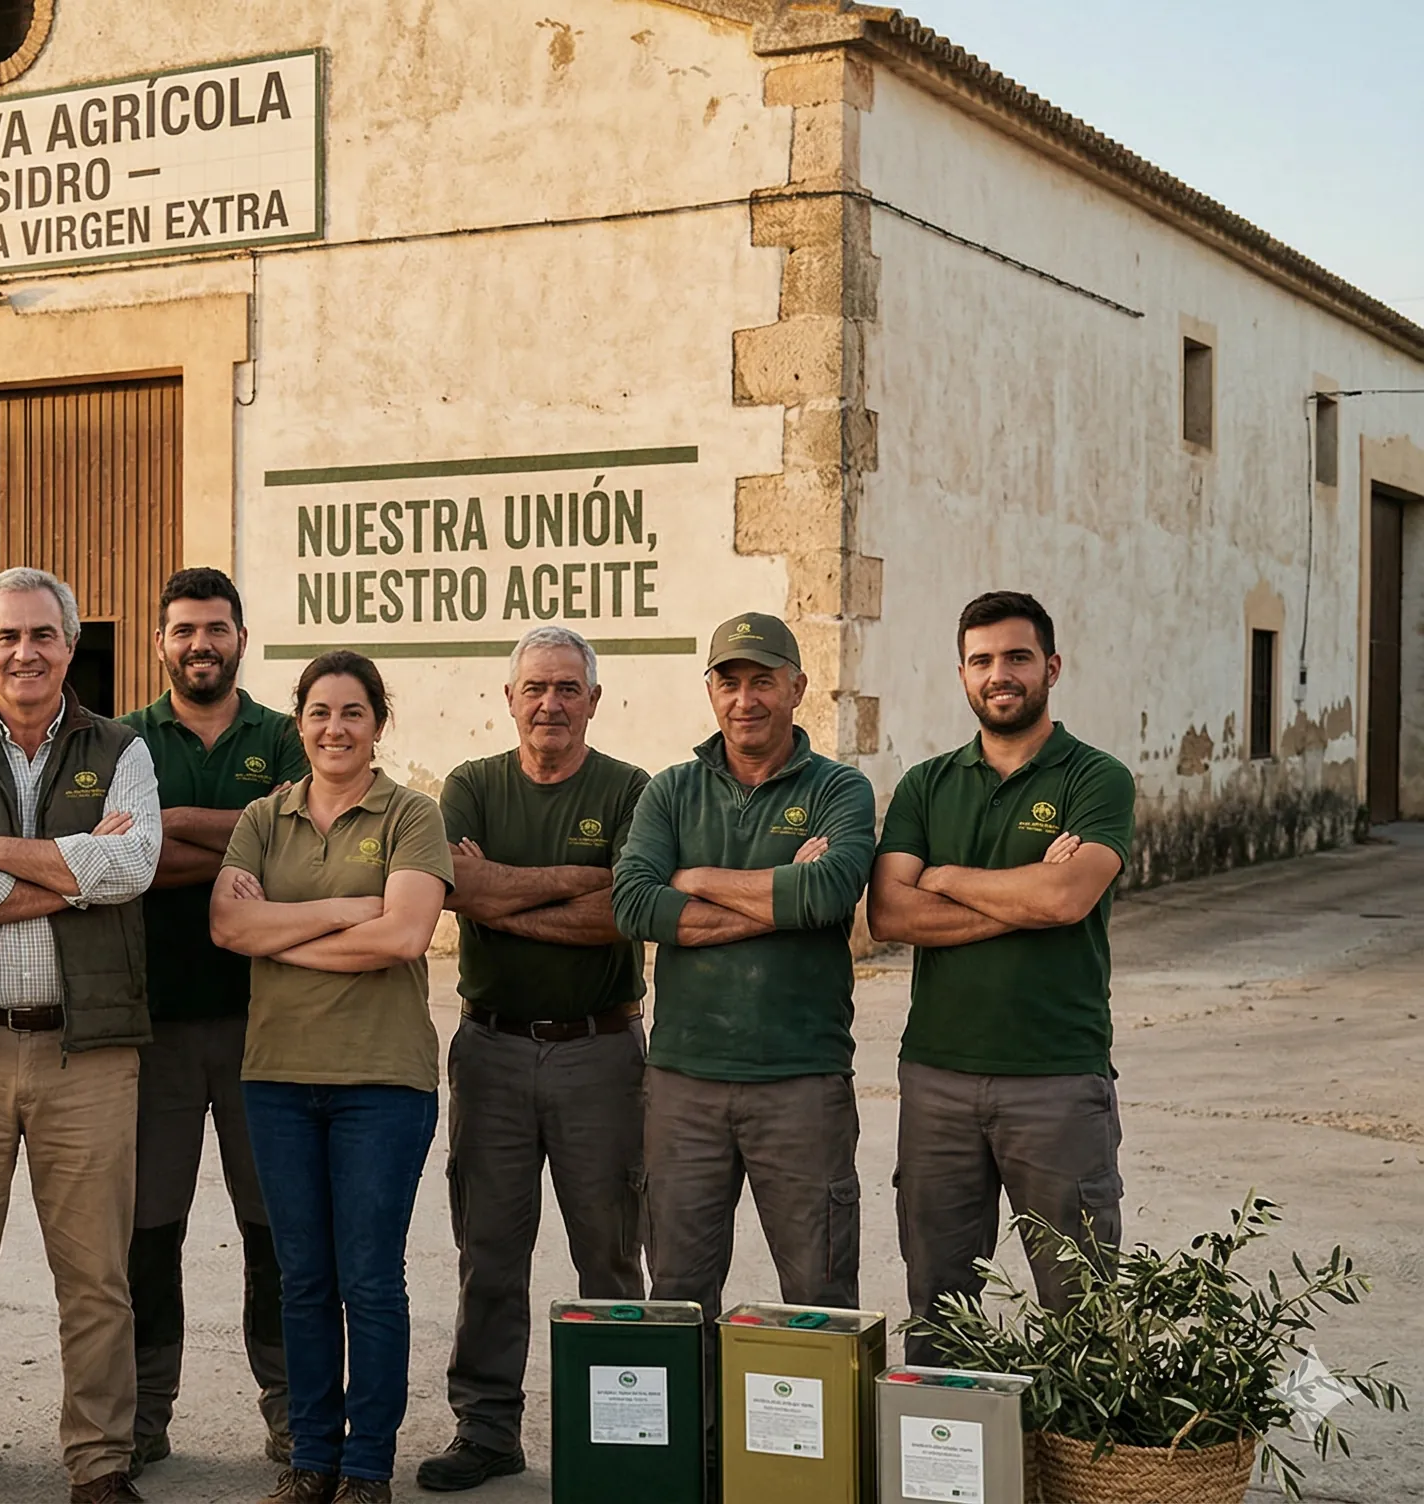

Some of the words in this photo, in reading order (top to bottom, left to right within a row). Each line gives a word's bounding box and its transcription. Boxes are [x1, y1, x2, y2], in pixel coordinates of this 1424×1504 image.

[46, 71, 291, 152] AGRÍCOLA
[21, 206, 150, 255] VIRGEN
[166, 190, 289, 240] EXTRA
[298, 497, 487, 557] NUESTRA
[504, 475, 657, 552] UNIÓN,
[298, 566, 487, 624] NUESTRO
[503, 561, 658, 620] ACEITE
